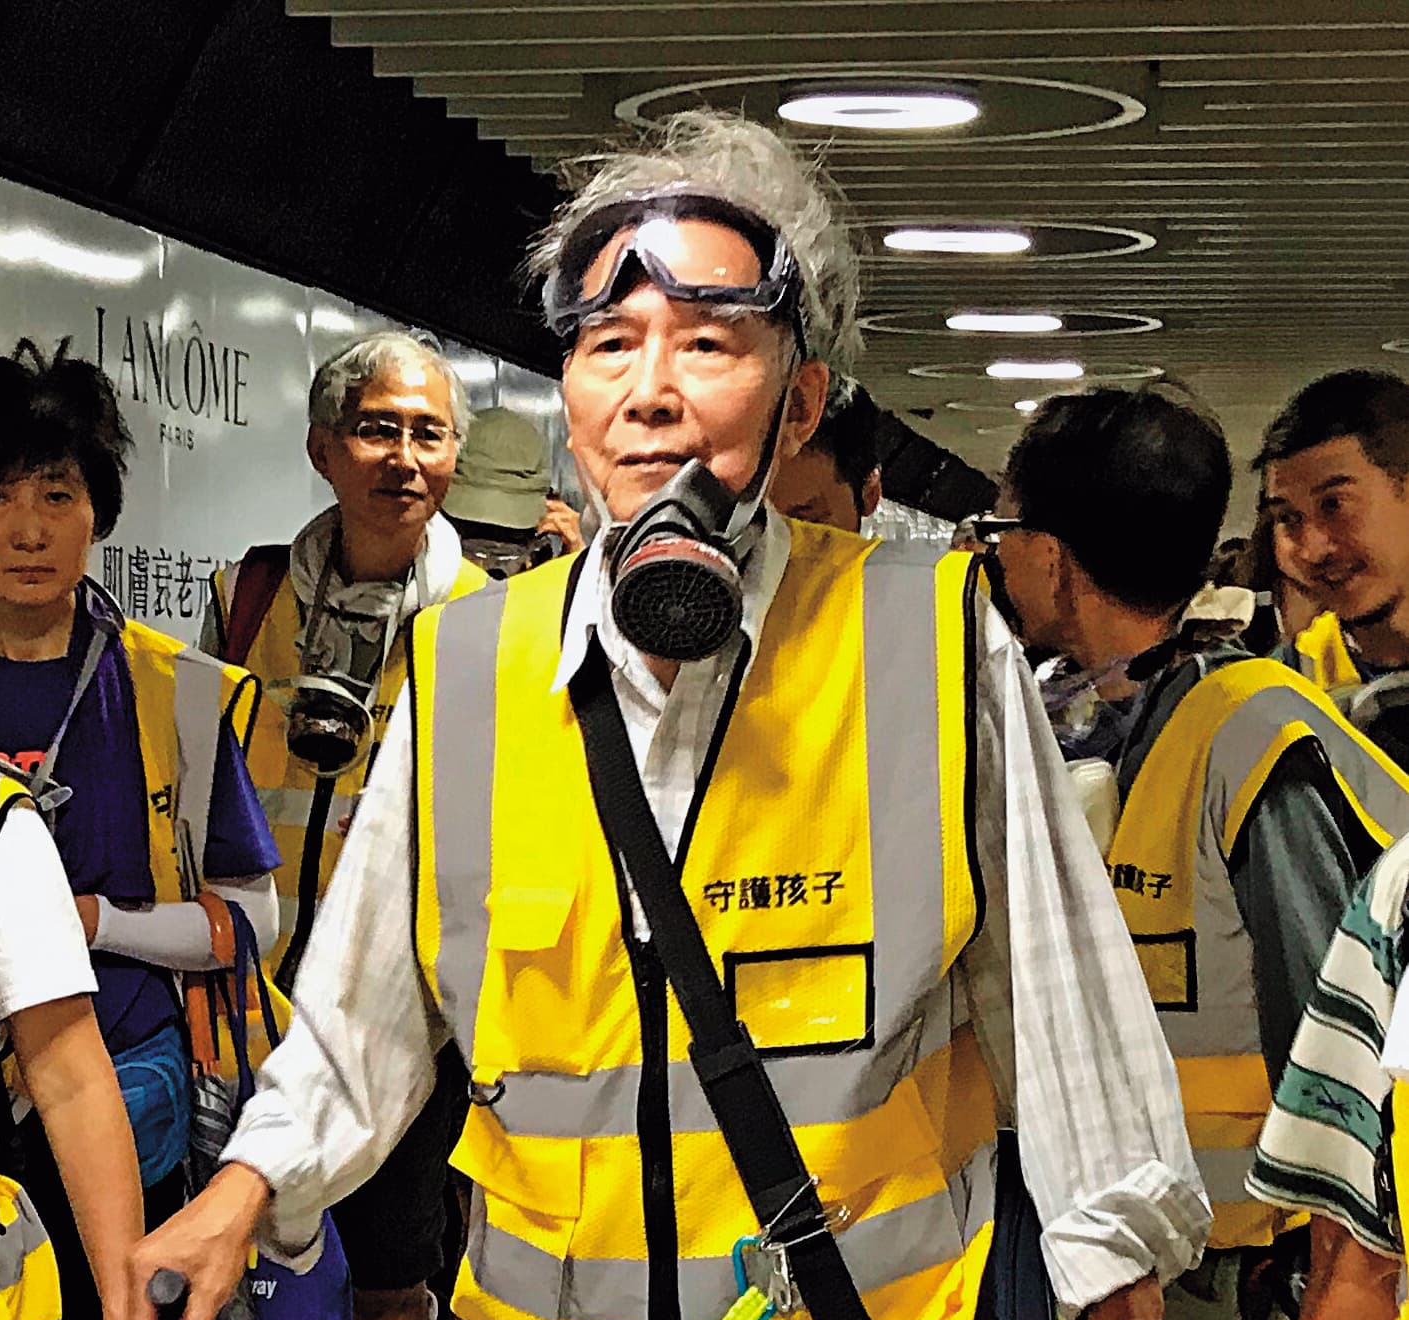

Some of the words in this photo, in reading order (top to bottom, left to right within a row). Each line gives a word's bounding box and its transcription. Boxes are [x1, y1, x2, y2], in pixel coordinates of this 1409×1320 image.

[160, 423, 194, 450] PARIS
[103, 546, 231, 619] 肌膚衰老元
[704, 871, 845, 912] 守護孩子
